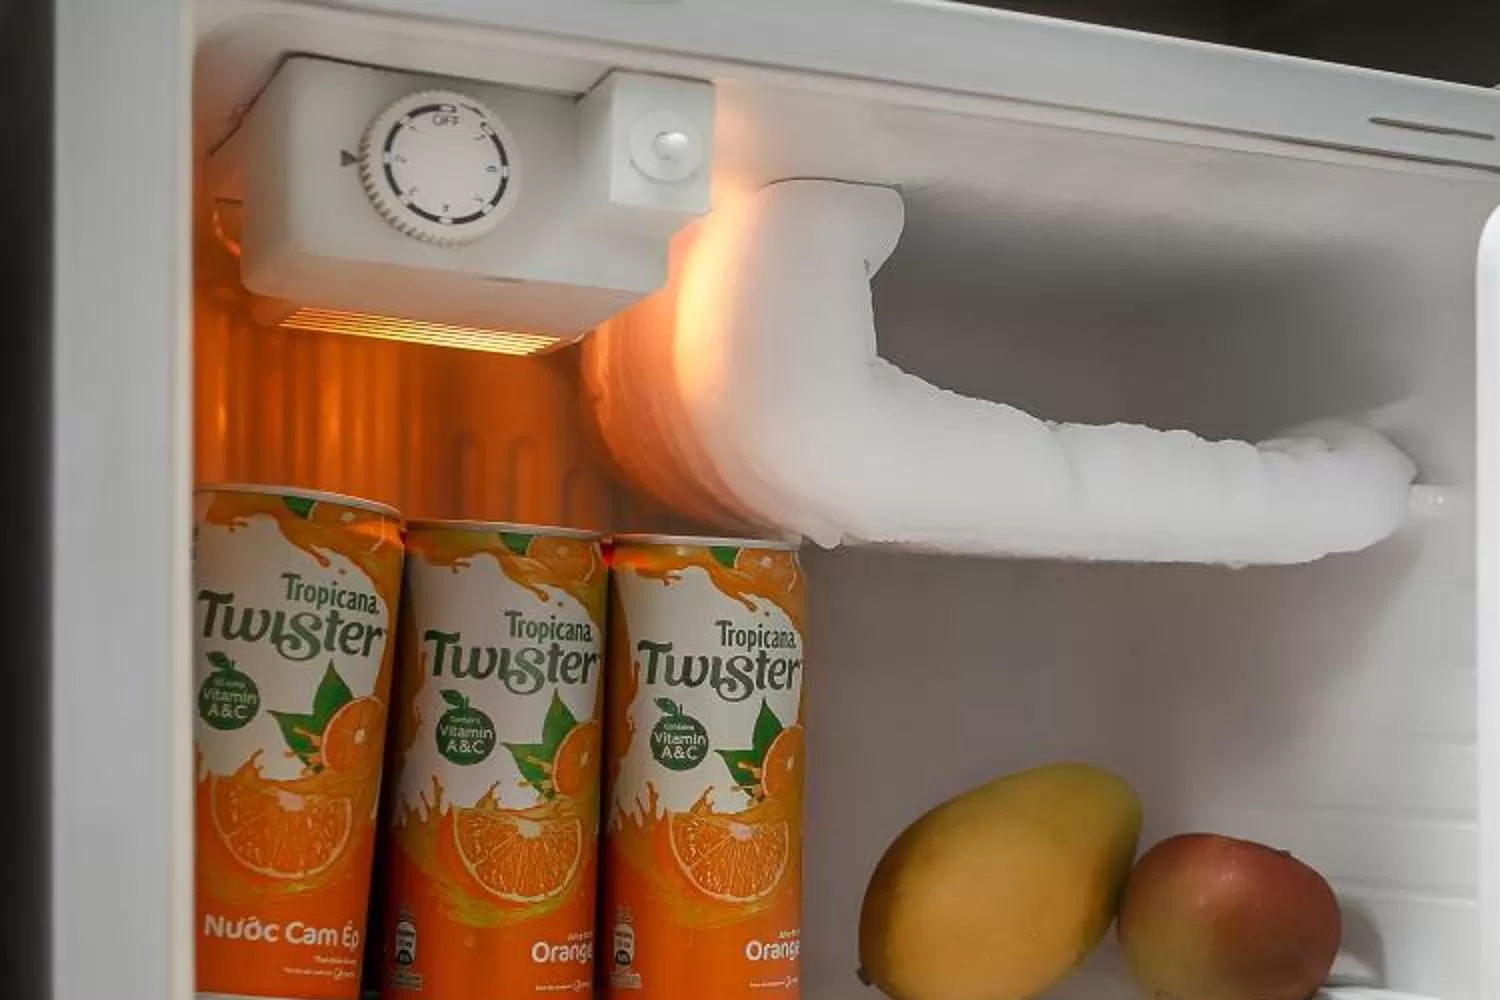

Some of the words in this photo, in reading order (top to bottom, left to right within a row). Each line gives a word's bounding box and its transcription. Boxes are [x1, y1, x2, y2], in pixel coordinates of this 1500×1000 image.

[281, 572, 380, 615] Tropicana
[198, 590, 384, 661] Twister
[504, 610, 593, 644] Tropicana
[715, 620, 797, 652] Tropicana
[424, 629, 597, 695] Twister
[638, 640, 800, 702] Twister
[439, 723, 493, 739] Vitamin
[653, 730, 707, 746] Vitamin
[446, 740, 485, 755] A&C
[660, 744, 698, 761] A&C
[284, 920, 338, 947] Cam
